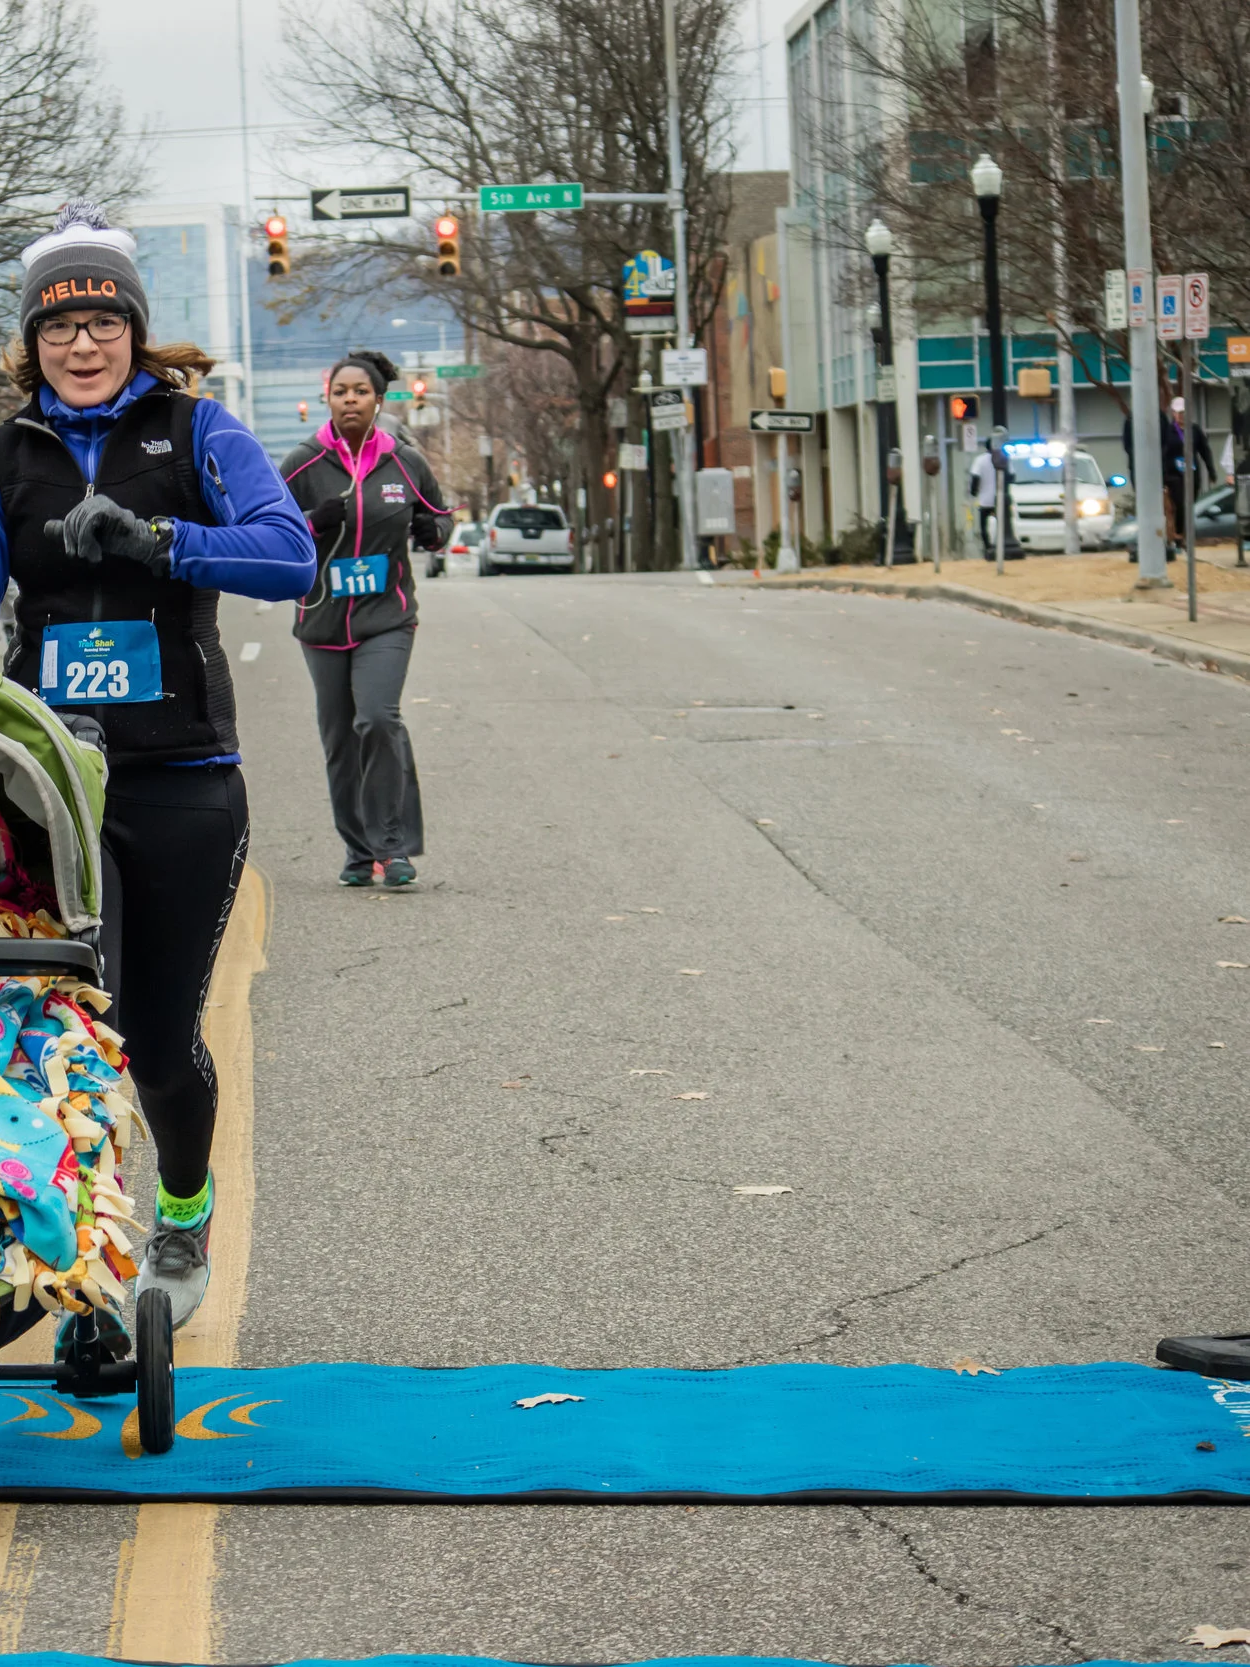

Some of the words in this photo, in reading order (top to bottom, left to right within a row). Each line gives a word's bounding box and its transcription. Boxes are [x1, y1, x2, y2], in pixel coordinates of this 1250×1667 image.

[341, 196, 365, 210] ONE
[372, 194, 398, 208] WAY
[490, 192, 514, 205] 5th
[526, 191, 551, 204] Ave
[563, 189, 574, 203] N
[41, 278, 117, 307] HELLO
[345, 573, 376, 594] 111
[95, 639, 115, 647] Shak
[66, 660, 130, 699] 223
